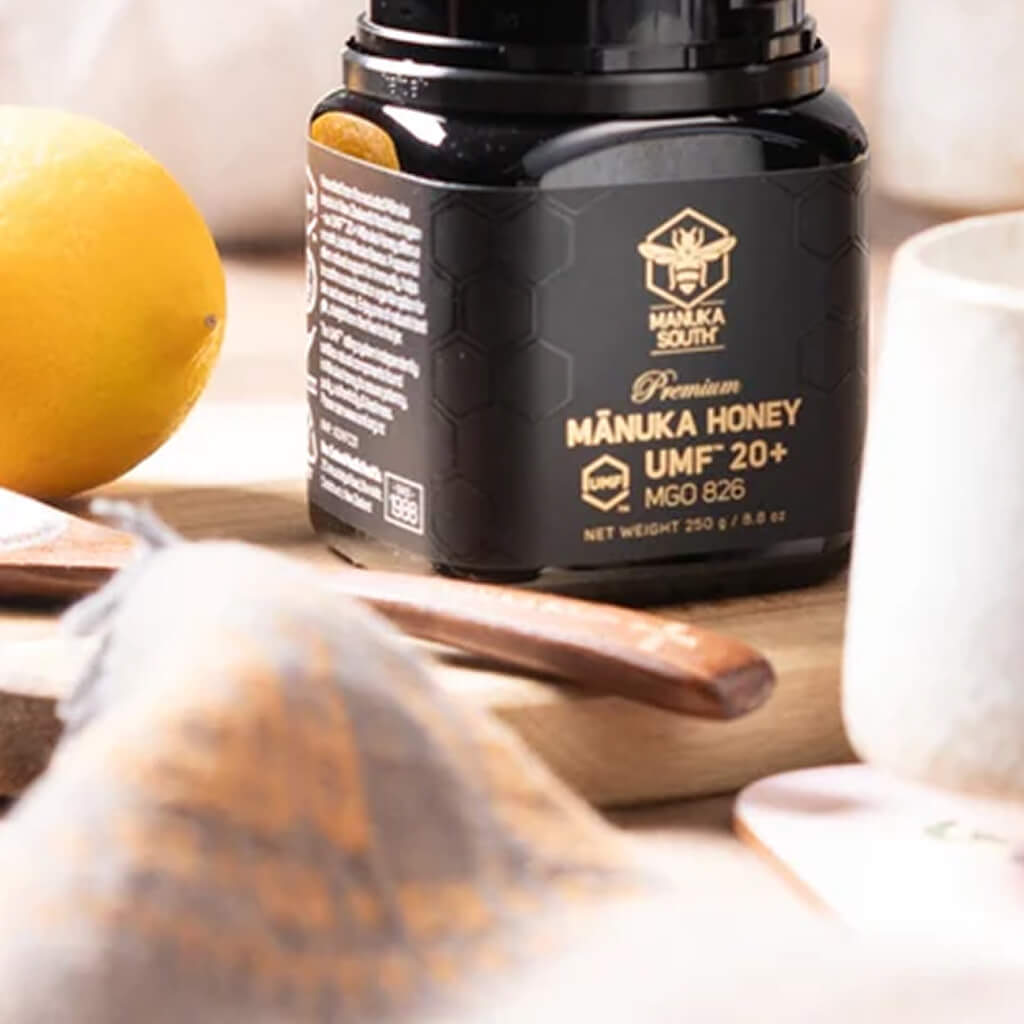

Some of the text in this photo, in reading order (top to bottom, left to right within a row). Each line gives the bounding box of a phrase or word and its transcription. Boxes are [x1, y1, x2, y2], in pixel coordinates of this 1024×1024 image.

[632, 368, 740, 404] Premium
[567, 397, 802, 448] MĀNUKA HONEY
[729, 439, 788, 472] 20+
[645, 478, 746, 509] MGO 826
[583, 526, 614, 543] NET
[619, 520, 680, 540] WEIGHT
[685, 516, 713, 533] 250
